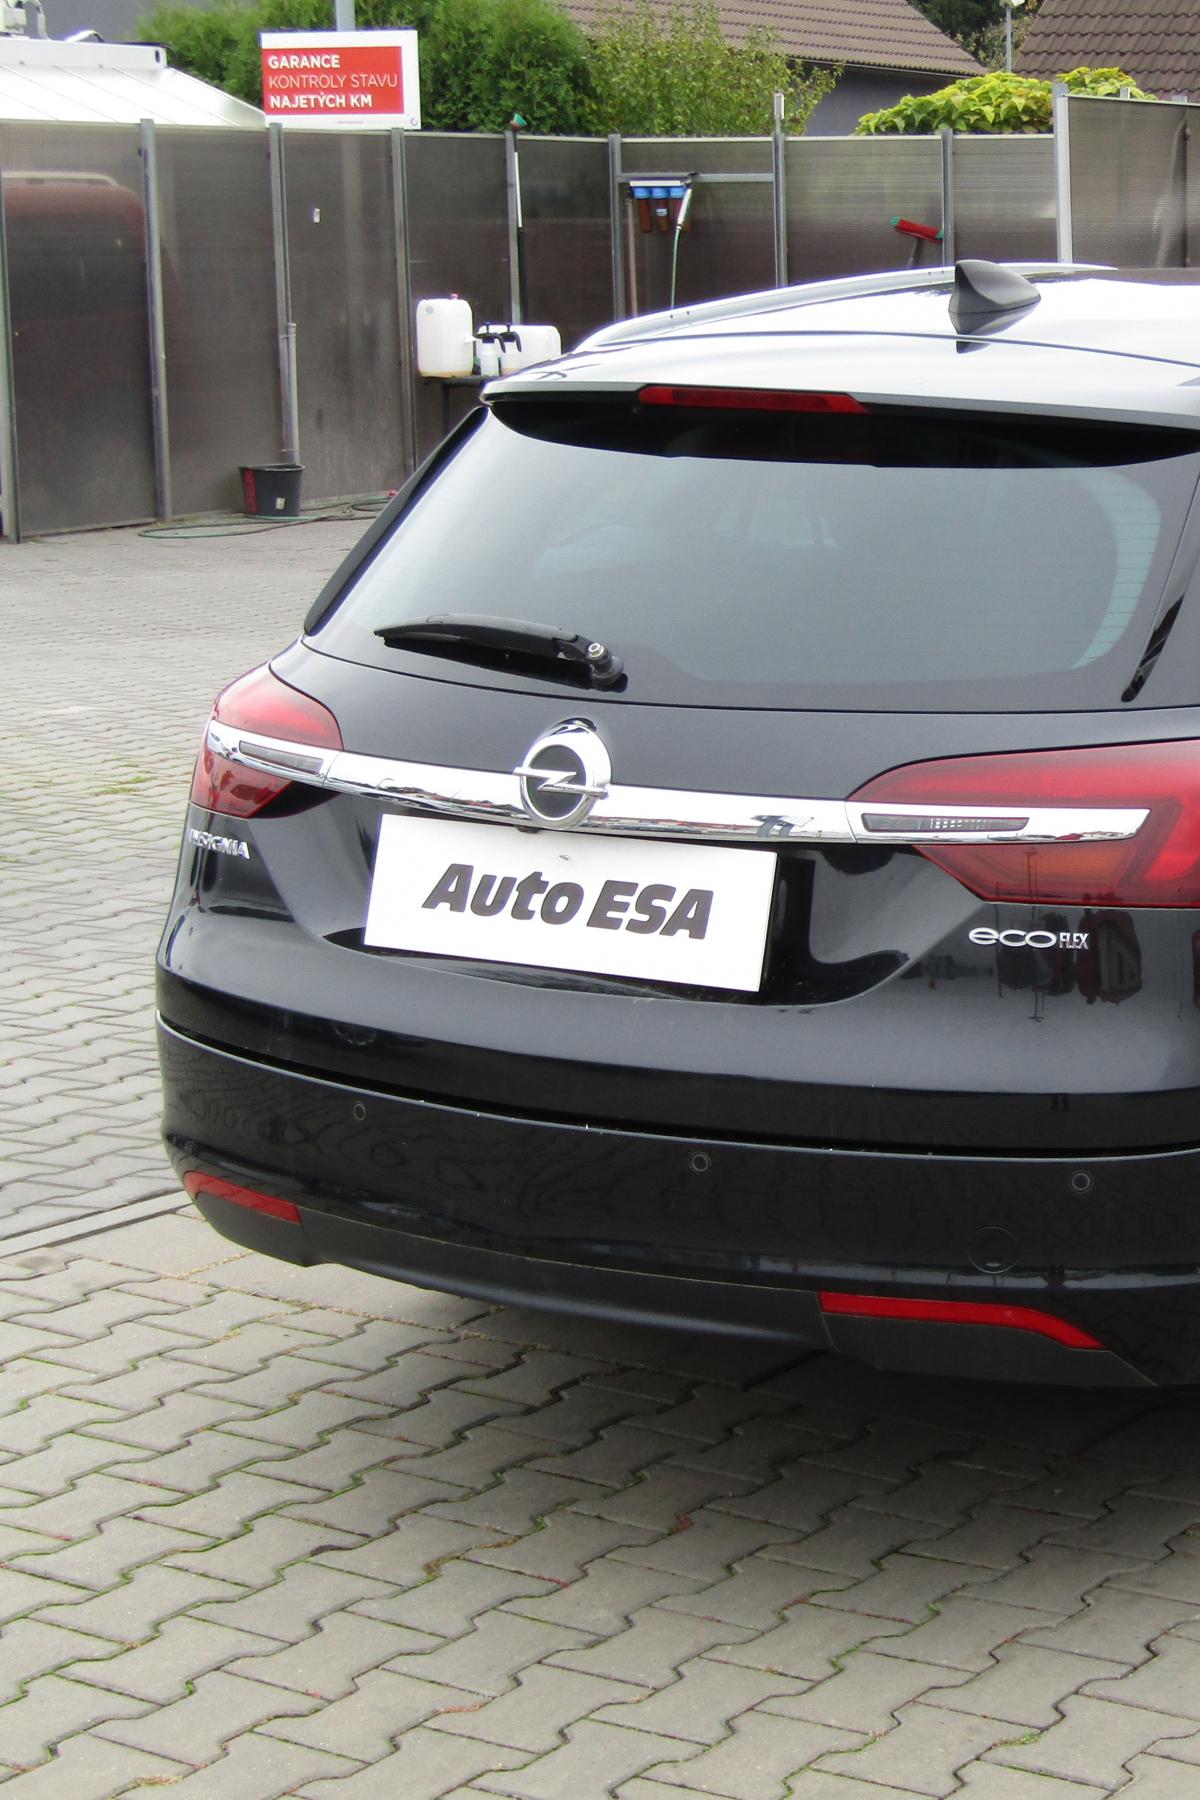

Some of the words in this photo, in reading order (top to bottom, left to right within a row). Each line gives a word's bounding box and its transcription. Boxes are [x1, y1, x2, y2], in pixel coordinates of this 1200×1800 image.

[268, 54, 340, 69] GARANCE
[269, 74, 346, 89] KONTROLY
[351, 73, 398, 88] STAVU
[270, 92, 345, 109] NAJETÝCH
[351, 94, 373, 108] KM
[421, 863, 585, 926] Auto
[586, 879, 714, 940] ESA
